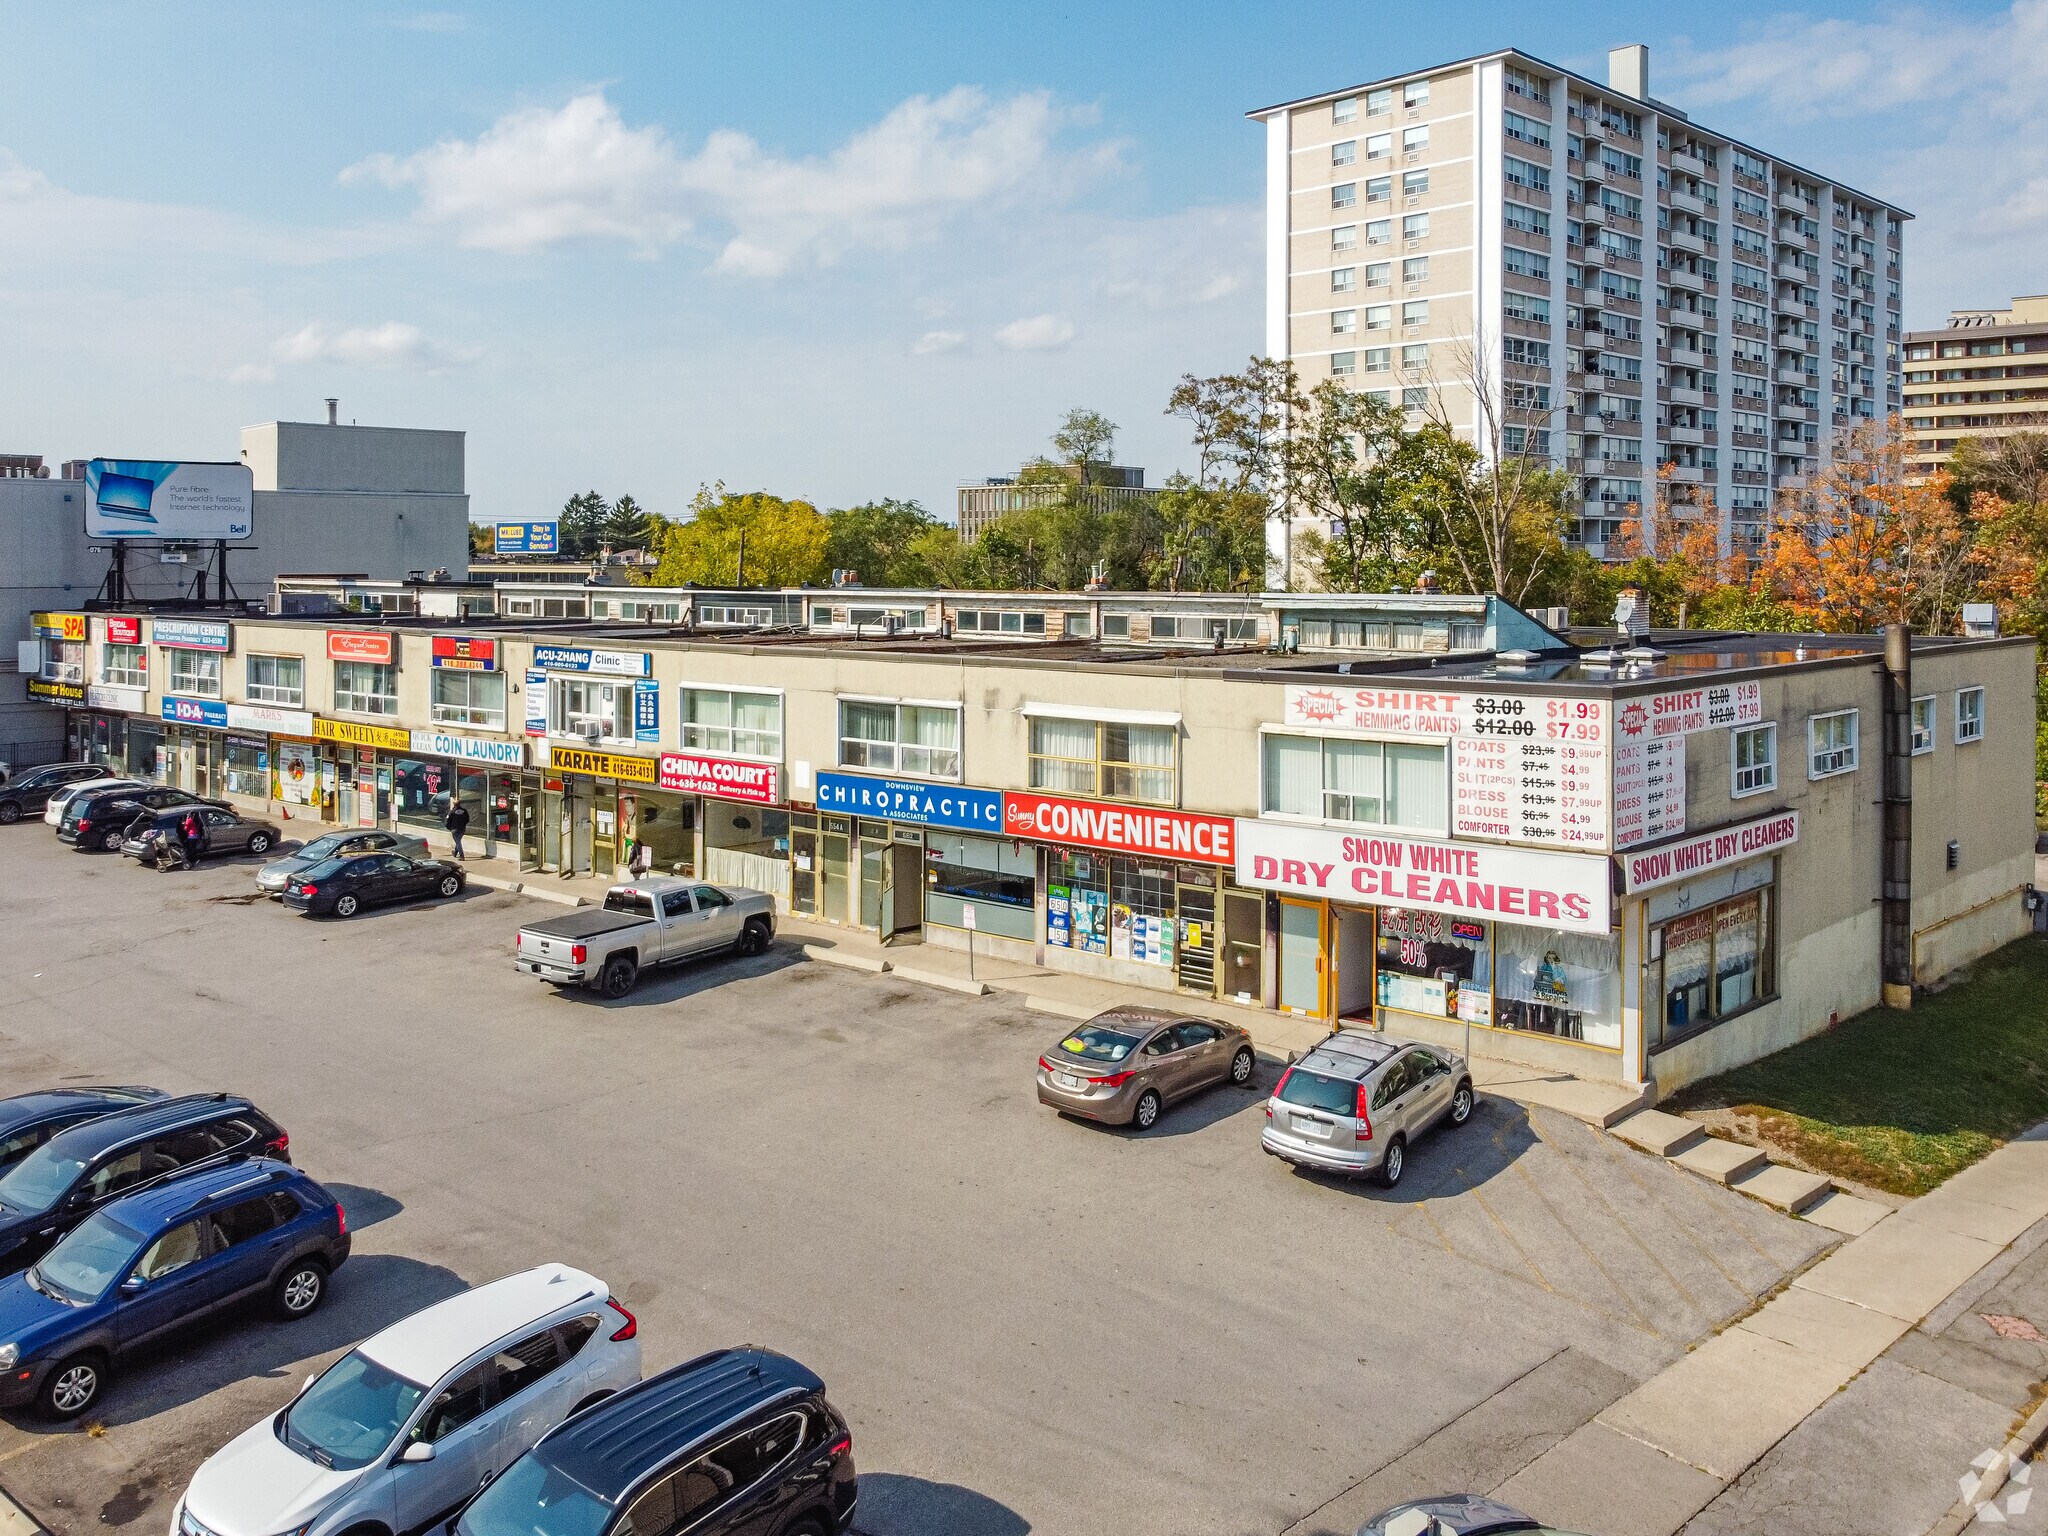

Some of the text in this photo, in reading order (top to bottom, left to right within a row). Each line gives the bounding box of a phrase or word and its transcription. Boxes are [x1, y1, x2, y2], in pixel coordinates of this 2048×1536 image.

[170, 494, 184, 502] The
[230, 524, 246, 533] Bell
[532, 525, 544, 533] Stay
[529, 542, 548, 550] Service
[64, 618, 84, 637] SPA
[154, 622, 226, 636] PRESCRIPTION CENTRE
[536, 650, 589, 664] ACU-ZHANG
[595, 654, 620, 666] Clinic
[29, 680, 58, 694] Summer
[60, 684, 83, 698] House
[1300, 696, 1340, 715] SPECIAL
[1355, 692, 1600, 720] SHIRT $3.00 $1.99
[1653, 684, 1758, 715] SHIRT $3.00 $1.99
[1355, 711, 1600, 741] HEMMING (PANTS) $12.00 $7.99
[1624, 709, 1645, 730] SPECIAL
[1653, 702, 1759, 736] HEMMING (PANTS) $12.00 $7.99
[314, 720, 335, 737] HAIR
[340, 724, 376, 743] SWEETY
[412, 742, 432, 752] CLEAN
[435, 736, 520, 763] COIN LAUNDRY
[1458, 740, 1602, 760] COATS $23.95 $9.99UP
[1616, 746, 1640, 760] COATS
[554, 750, 609, 773] KARATE
[613, 763, 653, 778] 416-633-4131
[662, 756, 768, 785] CHINA COURT
[1522, 761, 1550, 772] $7.45
[1561, 763, 1590, 776] $4.99
[1616, 763, 1640, 778] PANTS
[662, 776, 717, 792] 416-636-1632
[719, 785, 741, 794] Delivery
[747, 788, 759, 796] Pick
[886, 782, 925, 792] DOWNSVIEW
[1522, 778, 1556, 789] $15.95
[1561, 780, 1590, 792] $9.99
[819, 784, 997, 821] CHIROPRACTIC
[1458, 788, 1602, 808] DRESS $13.95 $7.99UP
[1617, 796, 1641, 811] DRESS
[890, 810, 928, 822] ASSOCIATES
[1458, 804, 1591, 825] BLOUSE $6.95 $4.99
[1617, 813, 1642, 828] BLOUSE
[1666, 804, 1679, 814] $4.99
[1007, 802, 1229, 858] Sunny CONVENIENCE
[1458, 820, 1604, 842] COMFORTER $30.95 $24.99UP
[1617, 828, 1643, 845] COMFORTER
[1342, 836, 1478, 878] SNOW WHITE
[1633, 816, 1794, 885] SNOW WHITE DRY CLEANERS
[1254, 854, 1591, 920] DRY CLEANERS
[1453, 923, 1482, 937] OPEN
[1670, 934, 1686, 949] HOUR
[1686, 924, 1711, 942] SERVICE
[1401, 938, 1427, 968] 50%
